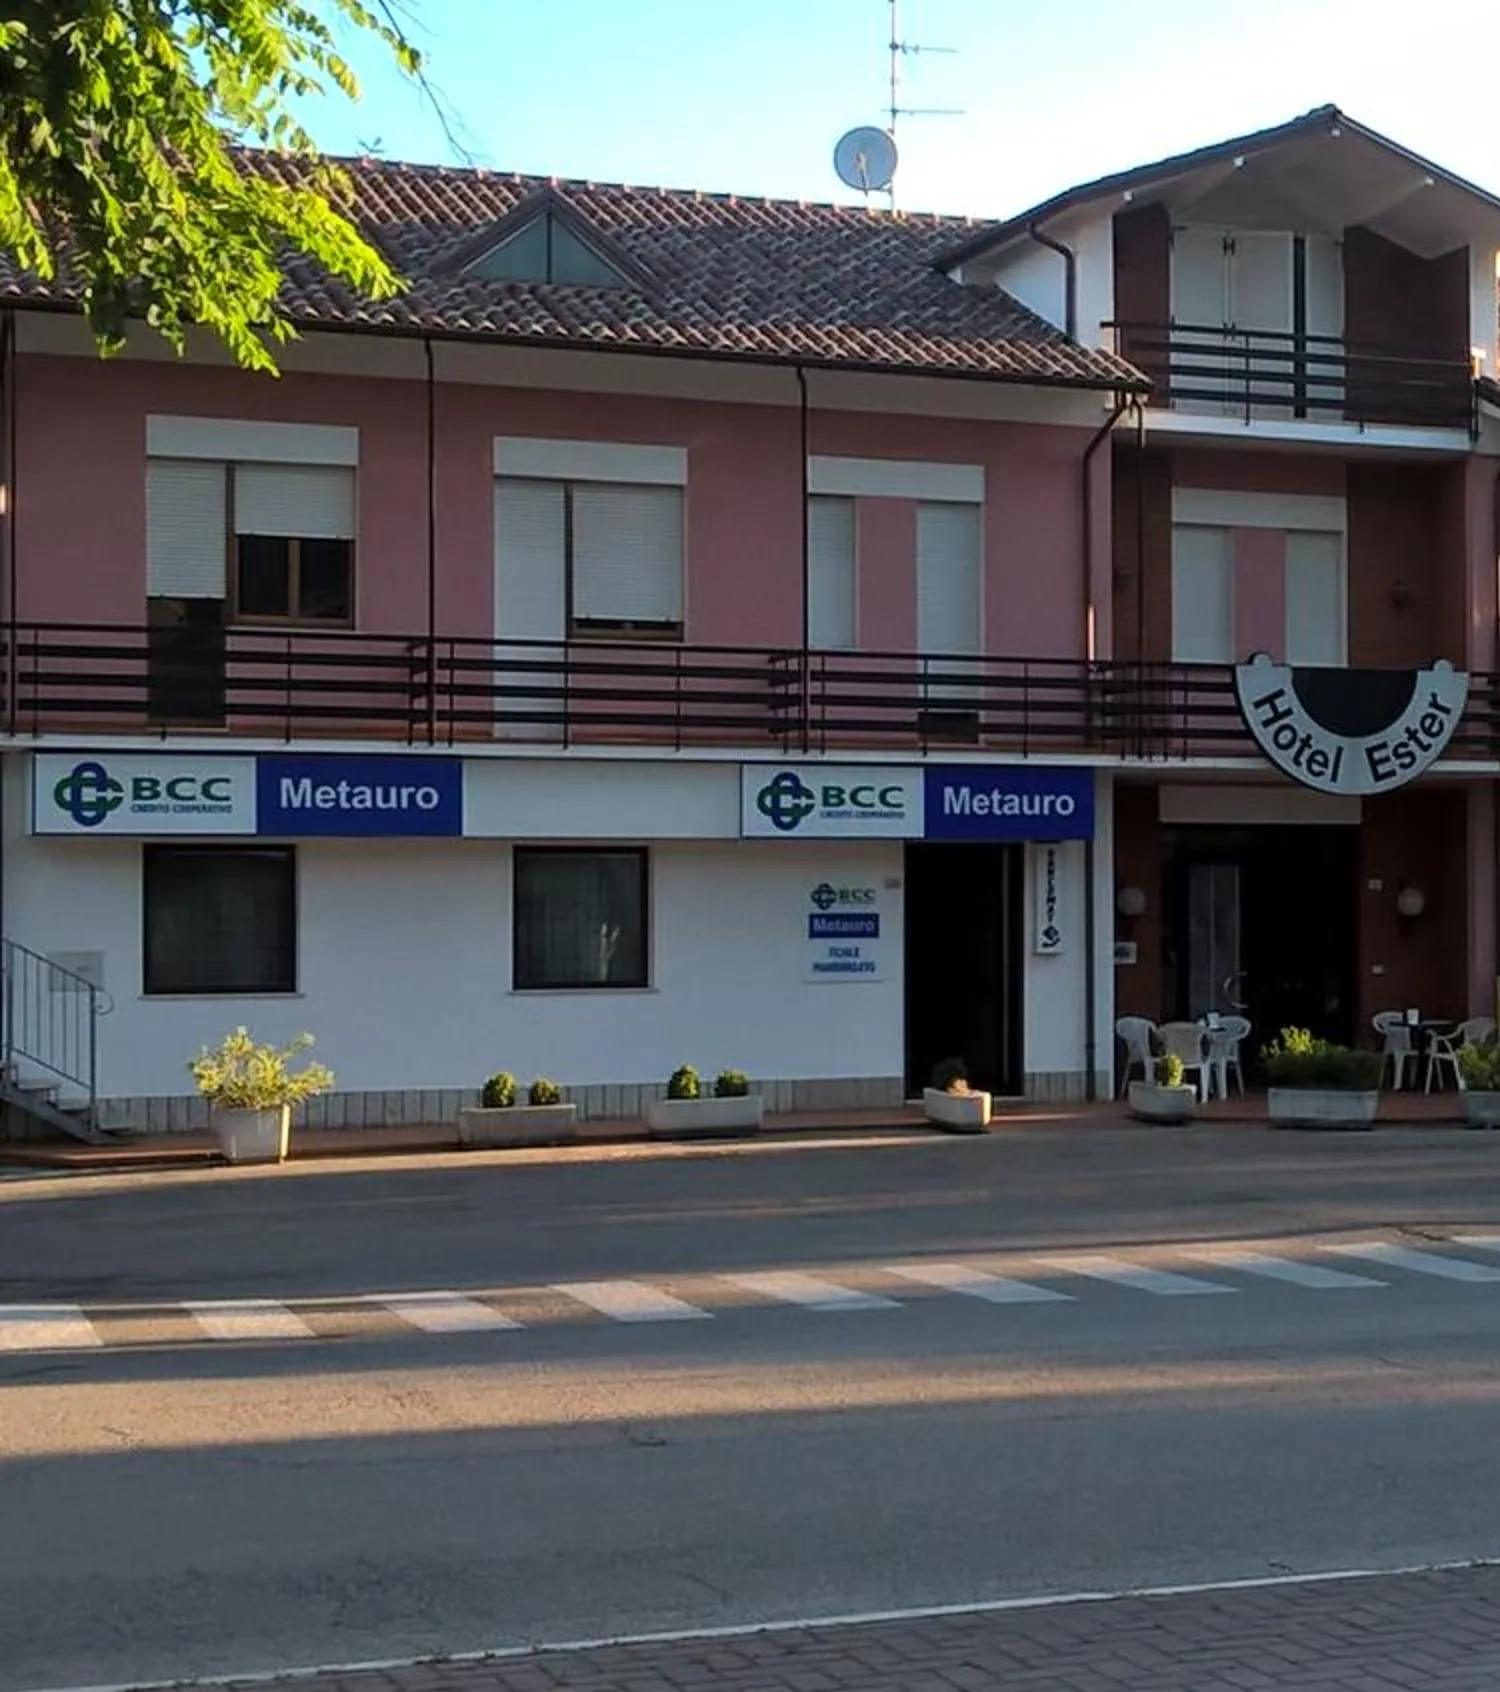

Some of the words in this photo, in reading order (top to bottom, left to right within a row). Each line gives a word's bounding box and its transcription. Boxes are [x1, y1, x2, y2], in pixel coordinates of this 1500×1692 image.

[1252, 688, 1344, 783] Hotel
[1365, 692, 1452, 783] Ester
[132, 777, 232, 801] BCC
[280, 777, 439, 809] Metauro
[821, 785, 904, 808] BCC
[943, 785, 1075, 816] Metauro
[812, 917, 875, 933] Metauro
